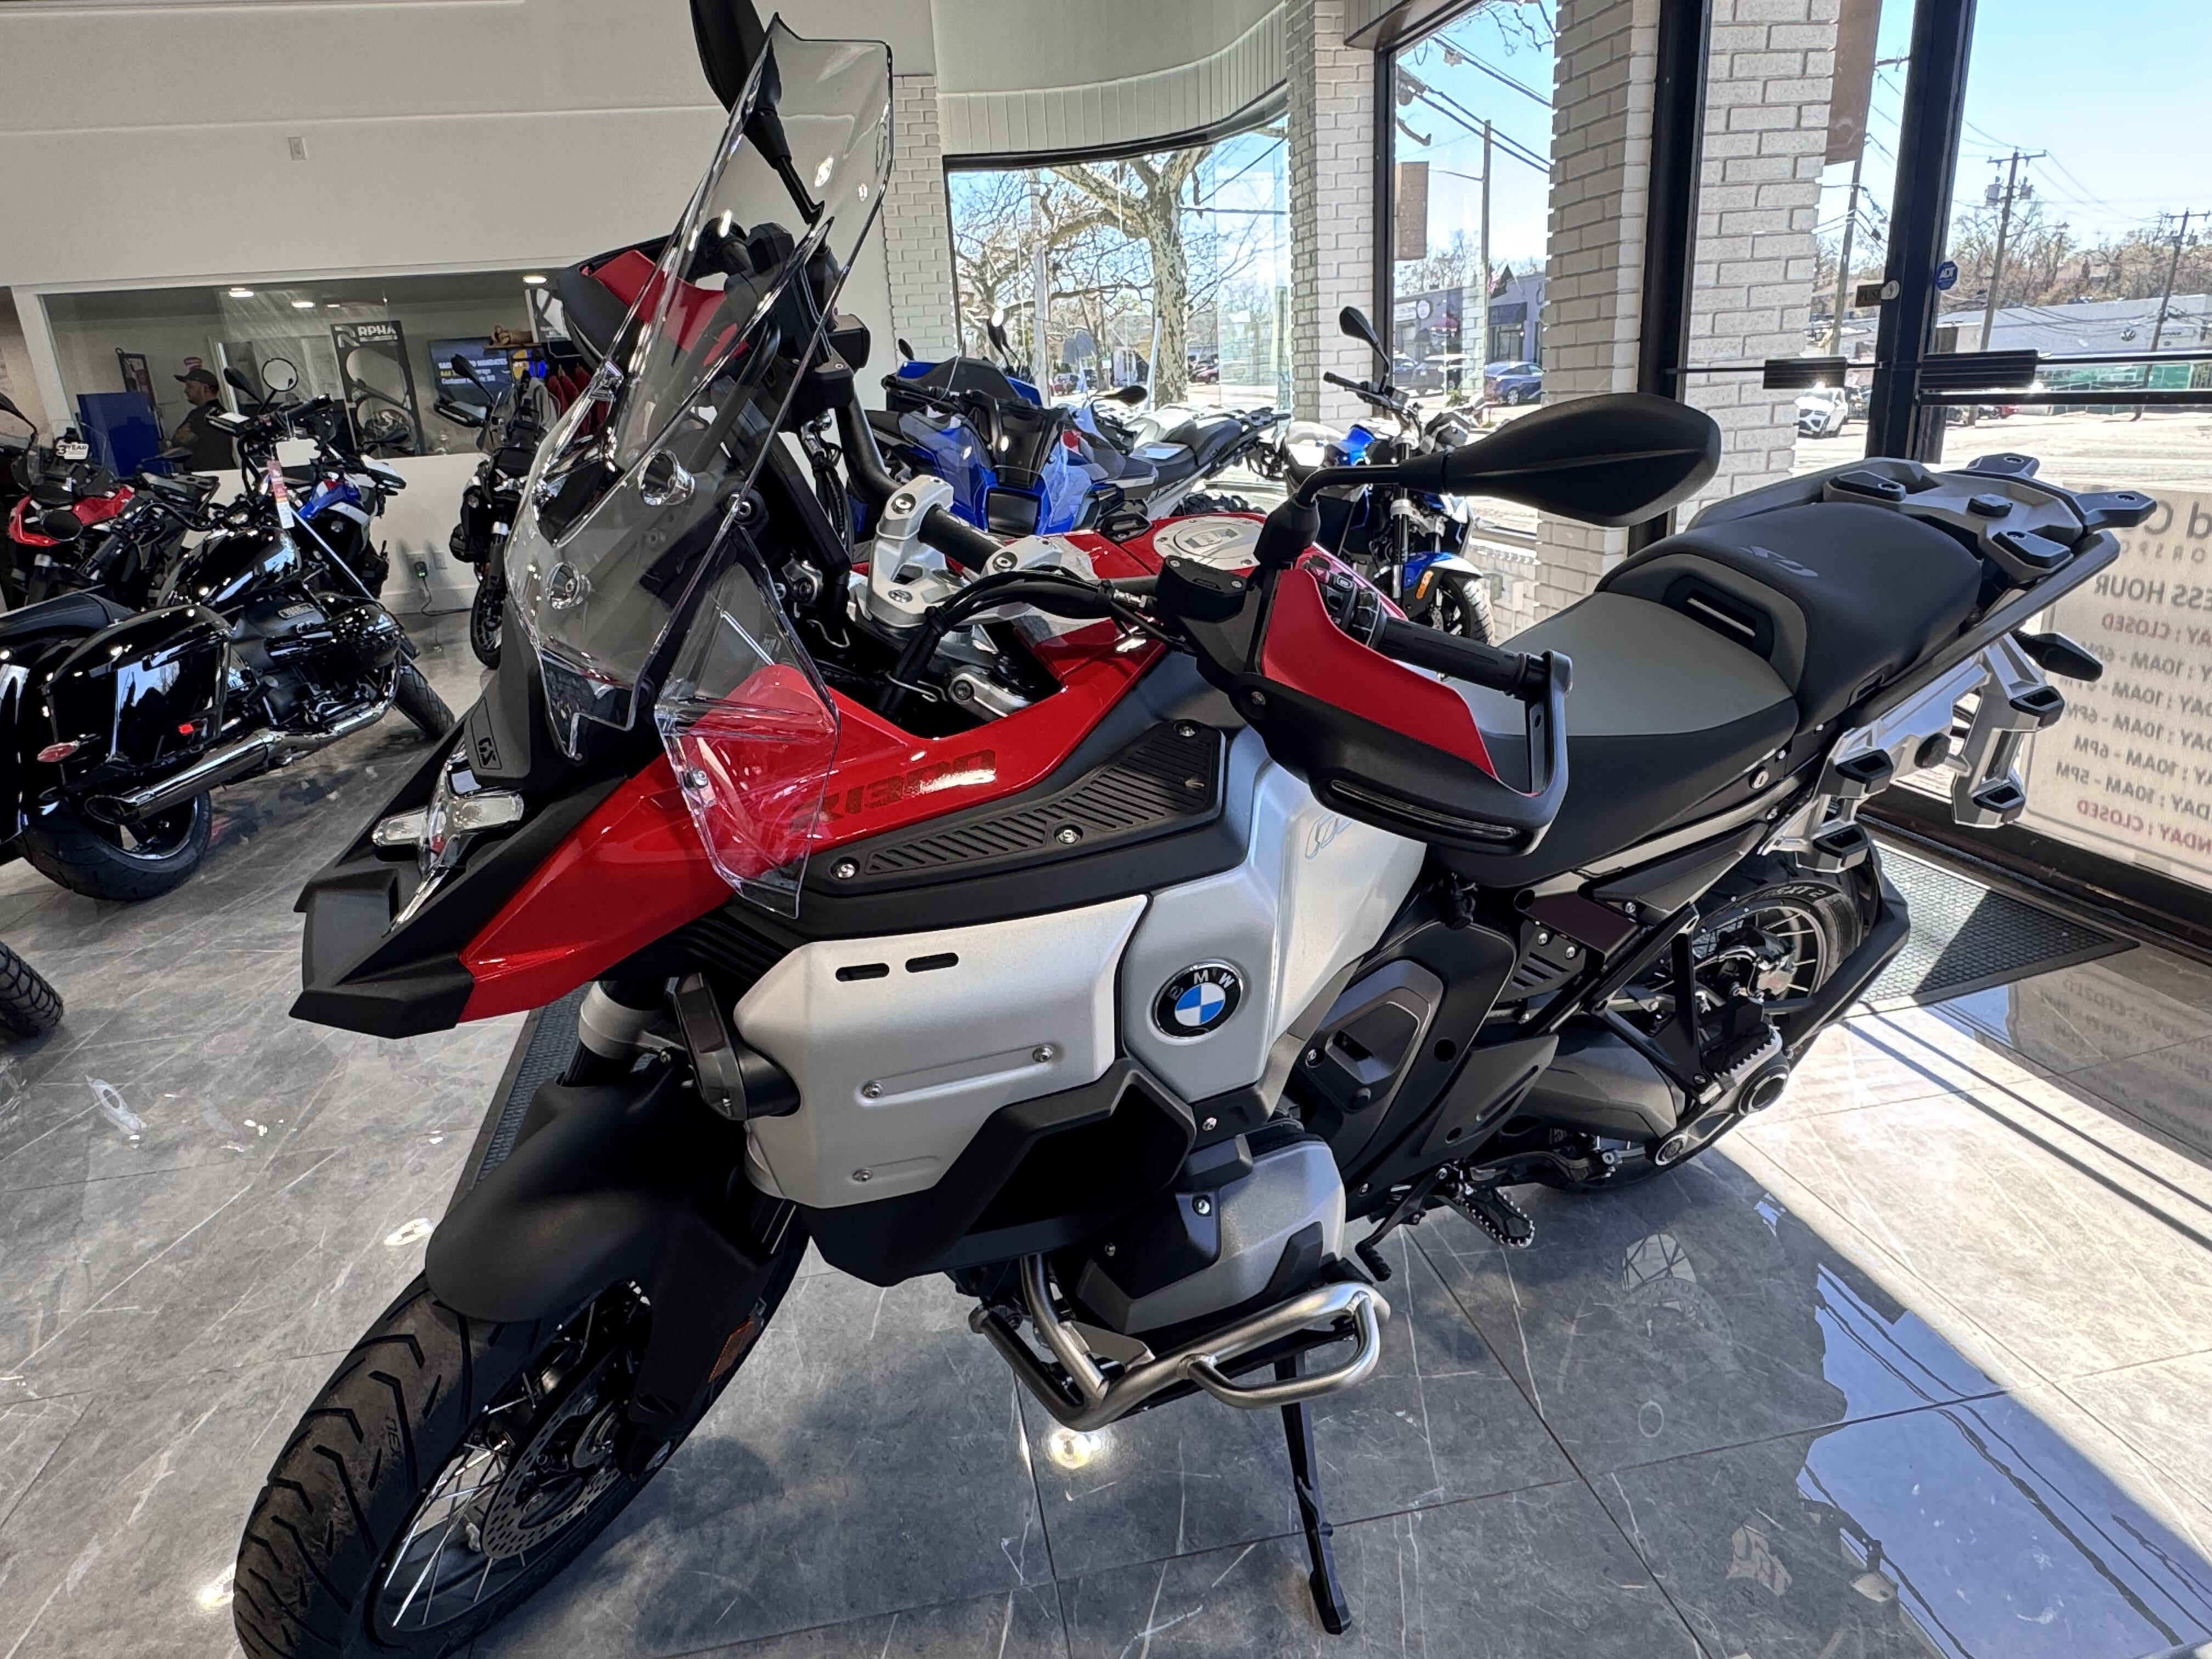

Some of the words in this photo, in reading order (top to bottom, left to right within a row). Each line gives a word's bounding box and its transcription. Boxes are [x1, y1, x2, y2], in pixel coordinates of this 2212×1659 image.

[1939, 266, 1957, 279] ADT
[1858, 289, 1881, 301] PUS
[357, 325, 397, 336] RPHA
[1167, 969, 1235, 1001] BMW
